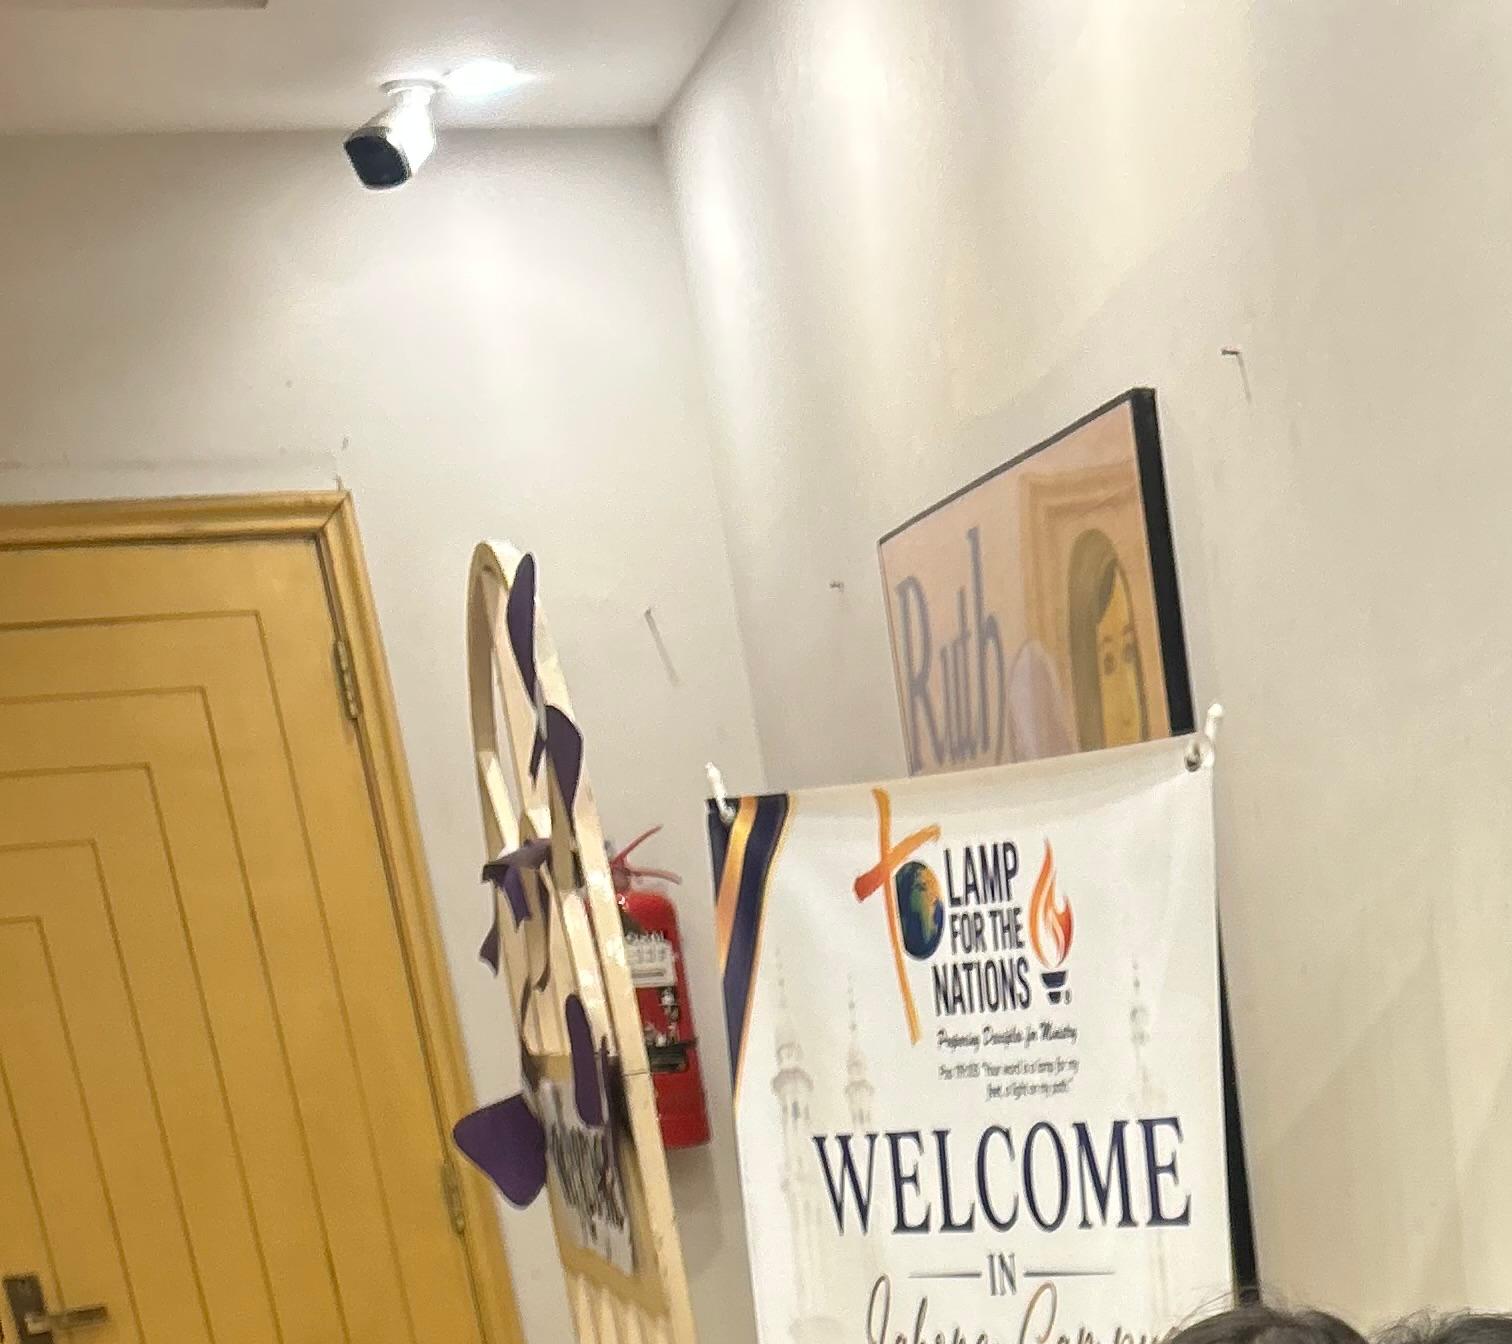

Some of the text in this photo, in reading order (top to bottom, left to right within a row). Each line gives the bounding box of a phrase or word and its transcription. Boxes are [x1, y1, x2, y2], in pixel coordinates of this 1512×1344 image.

[896, 526, 1005, 776] Ruth
[943, 841, 1020, 908] LAMP
[950, 907, 1026, 955] FOR THE
[931, 956, 1032, 1017] NATIONS
[812, 1116, 1192, 1236] WELCOME
[986, 1253, 1017, 1296] IN
